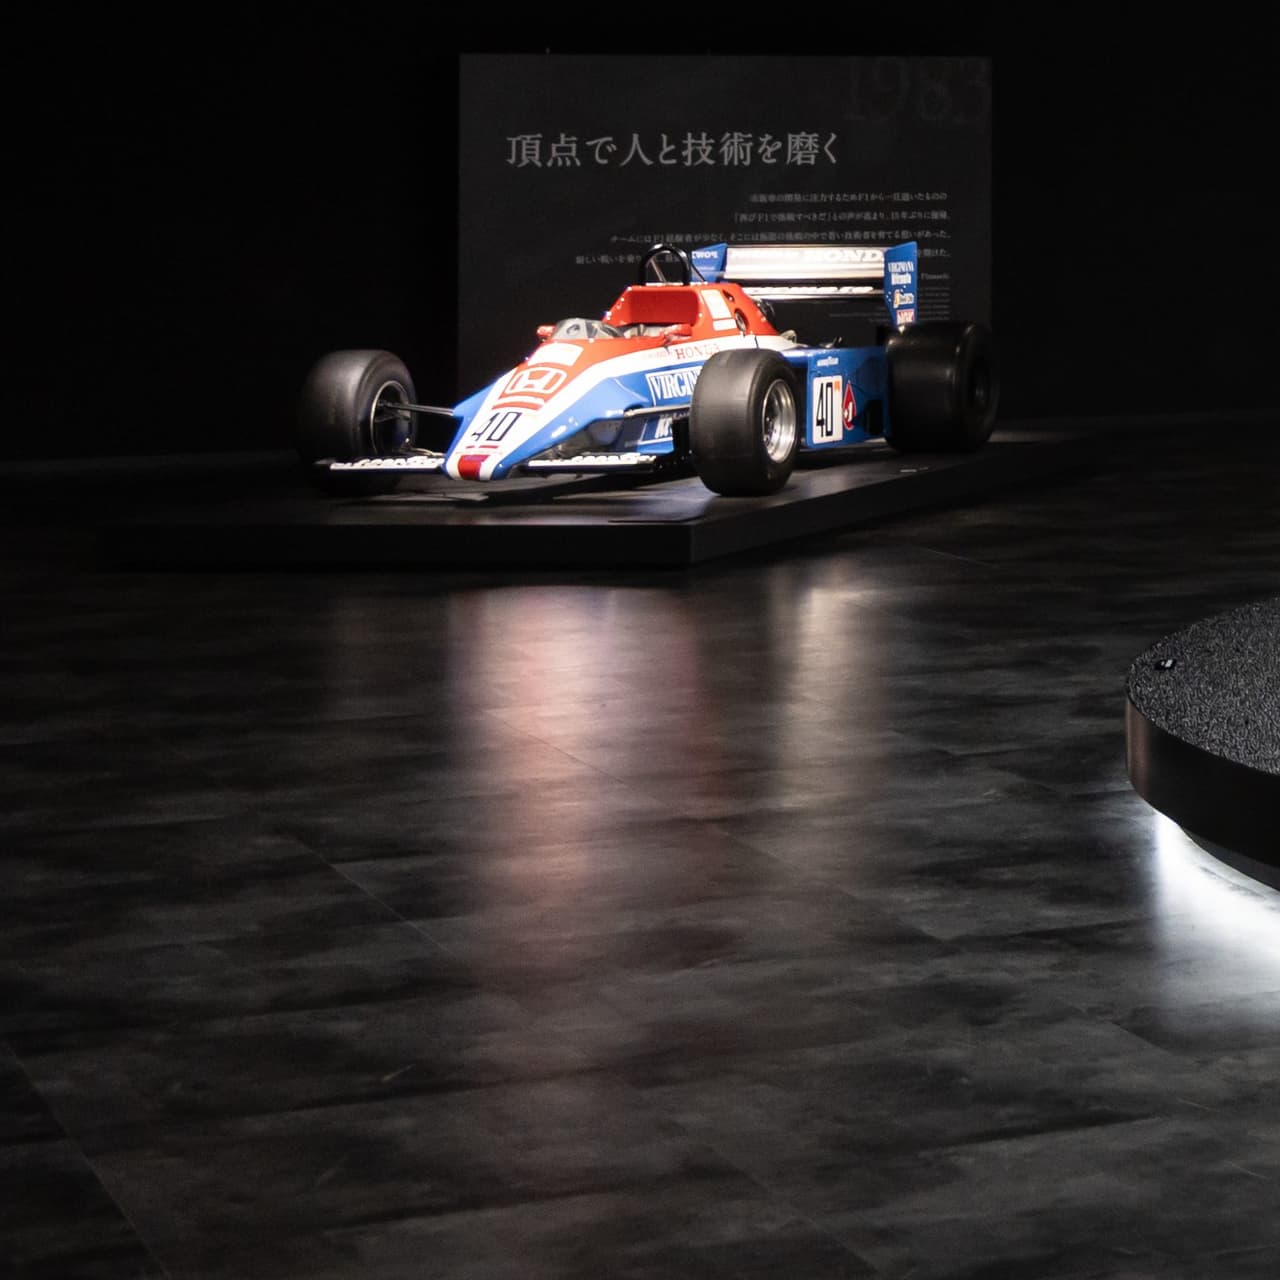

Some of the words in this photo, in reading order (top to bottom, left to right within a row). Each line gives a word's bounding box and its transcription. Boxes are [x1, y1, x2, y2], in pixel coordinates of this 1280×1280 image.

[505, 132, 839, 167] 頂点で人と技術を磨く
[471, 411, 523, 442] 40
[815, 381, 833, 438] 40
